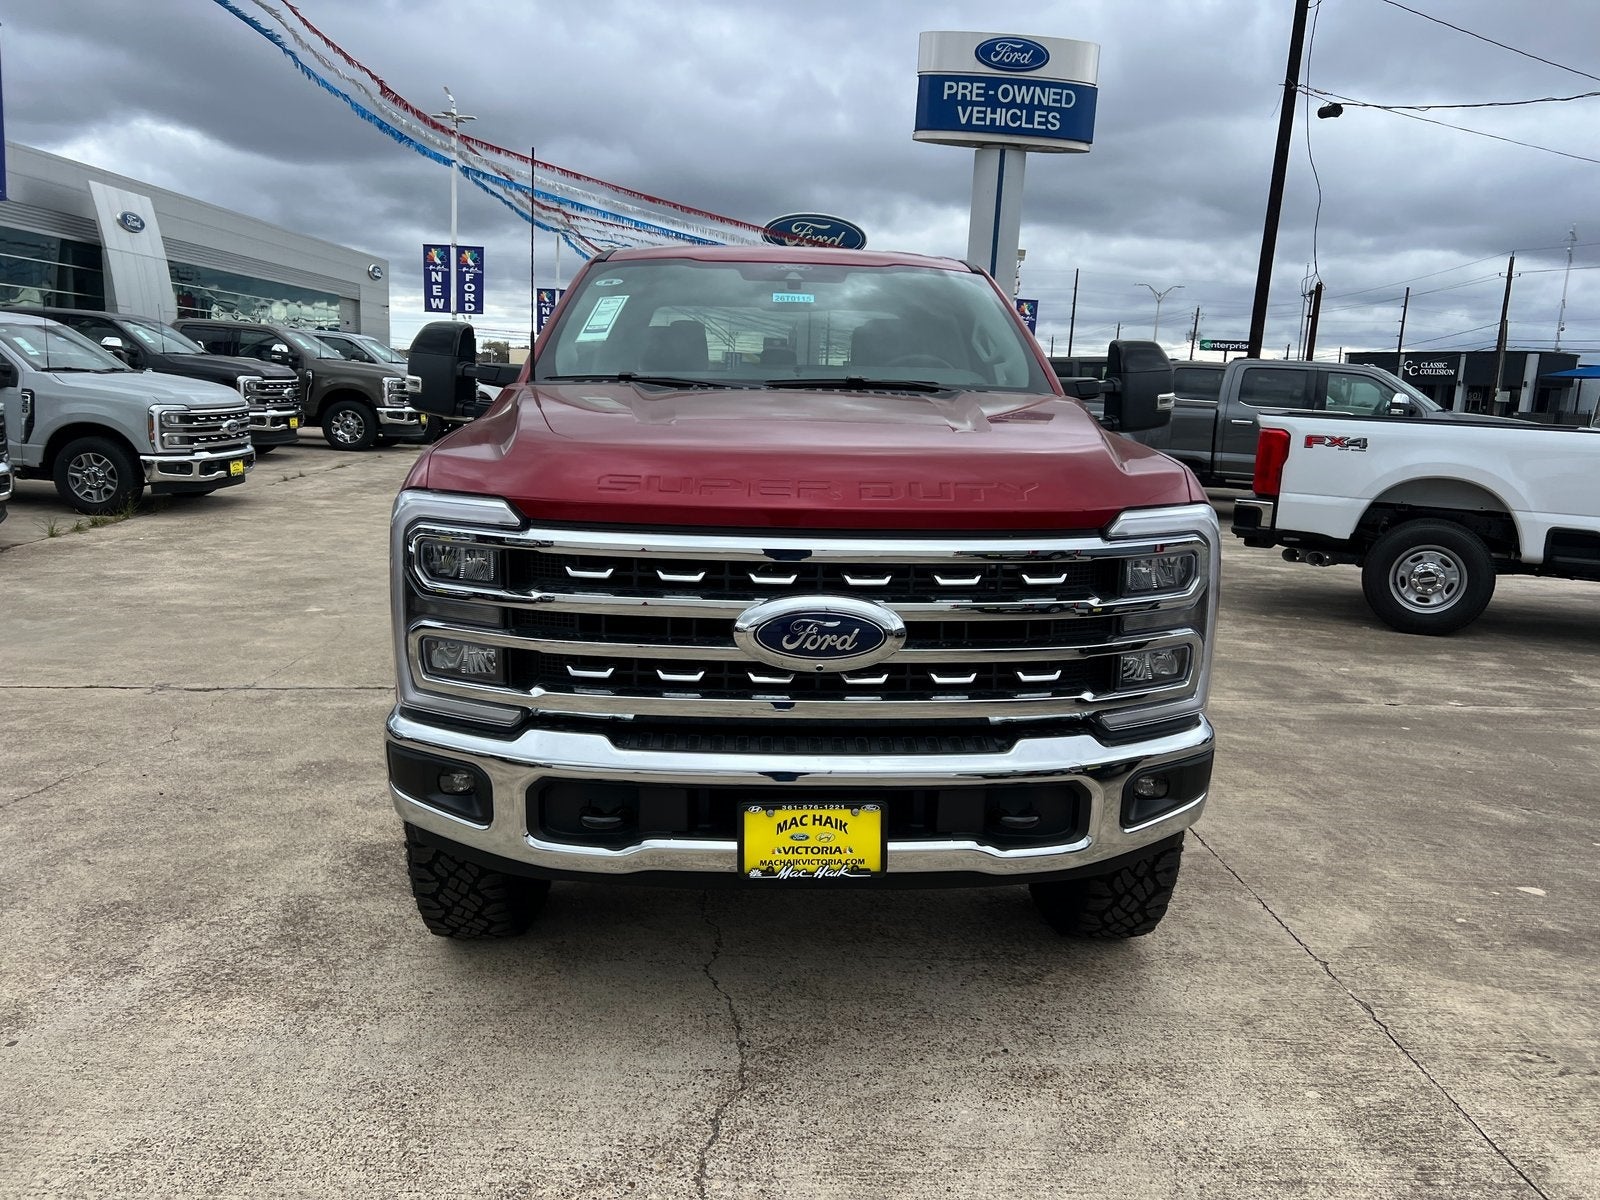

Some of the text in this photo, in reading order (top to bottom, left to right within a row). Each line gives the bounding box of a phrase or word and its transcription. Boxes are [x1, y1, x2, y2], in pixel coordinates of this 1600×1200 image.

[990, 42, 1034, 64] Ford
[957, 106, 1061, 131] VEHICLES
[430, 271, 445, 309] NEW
[463, 273, 476, 311] FORD
[1419, 368, 1455, 376] COLLISION
[1420, 361, 1447, 369] CLASSIC
[1304, 434, 1368, 449] FX4
[597, 474, 1040, 503] SUPER DUTY
[781, 618, 860, 651] Ford
[776, 814, 848, 835] MAC HAIK
[782, 846, 842, 855] VICTORIA
[777, 864, 850, 879] Mac Haik
